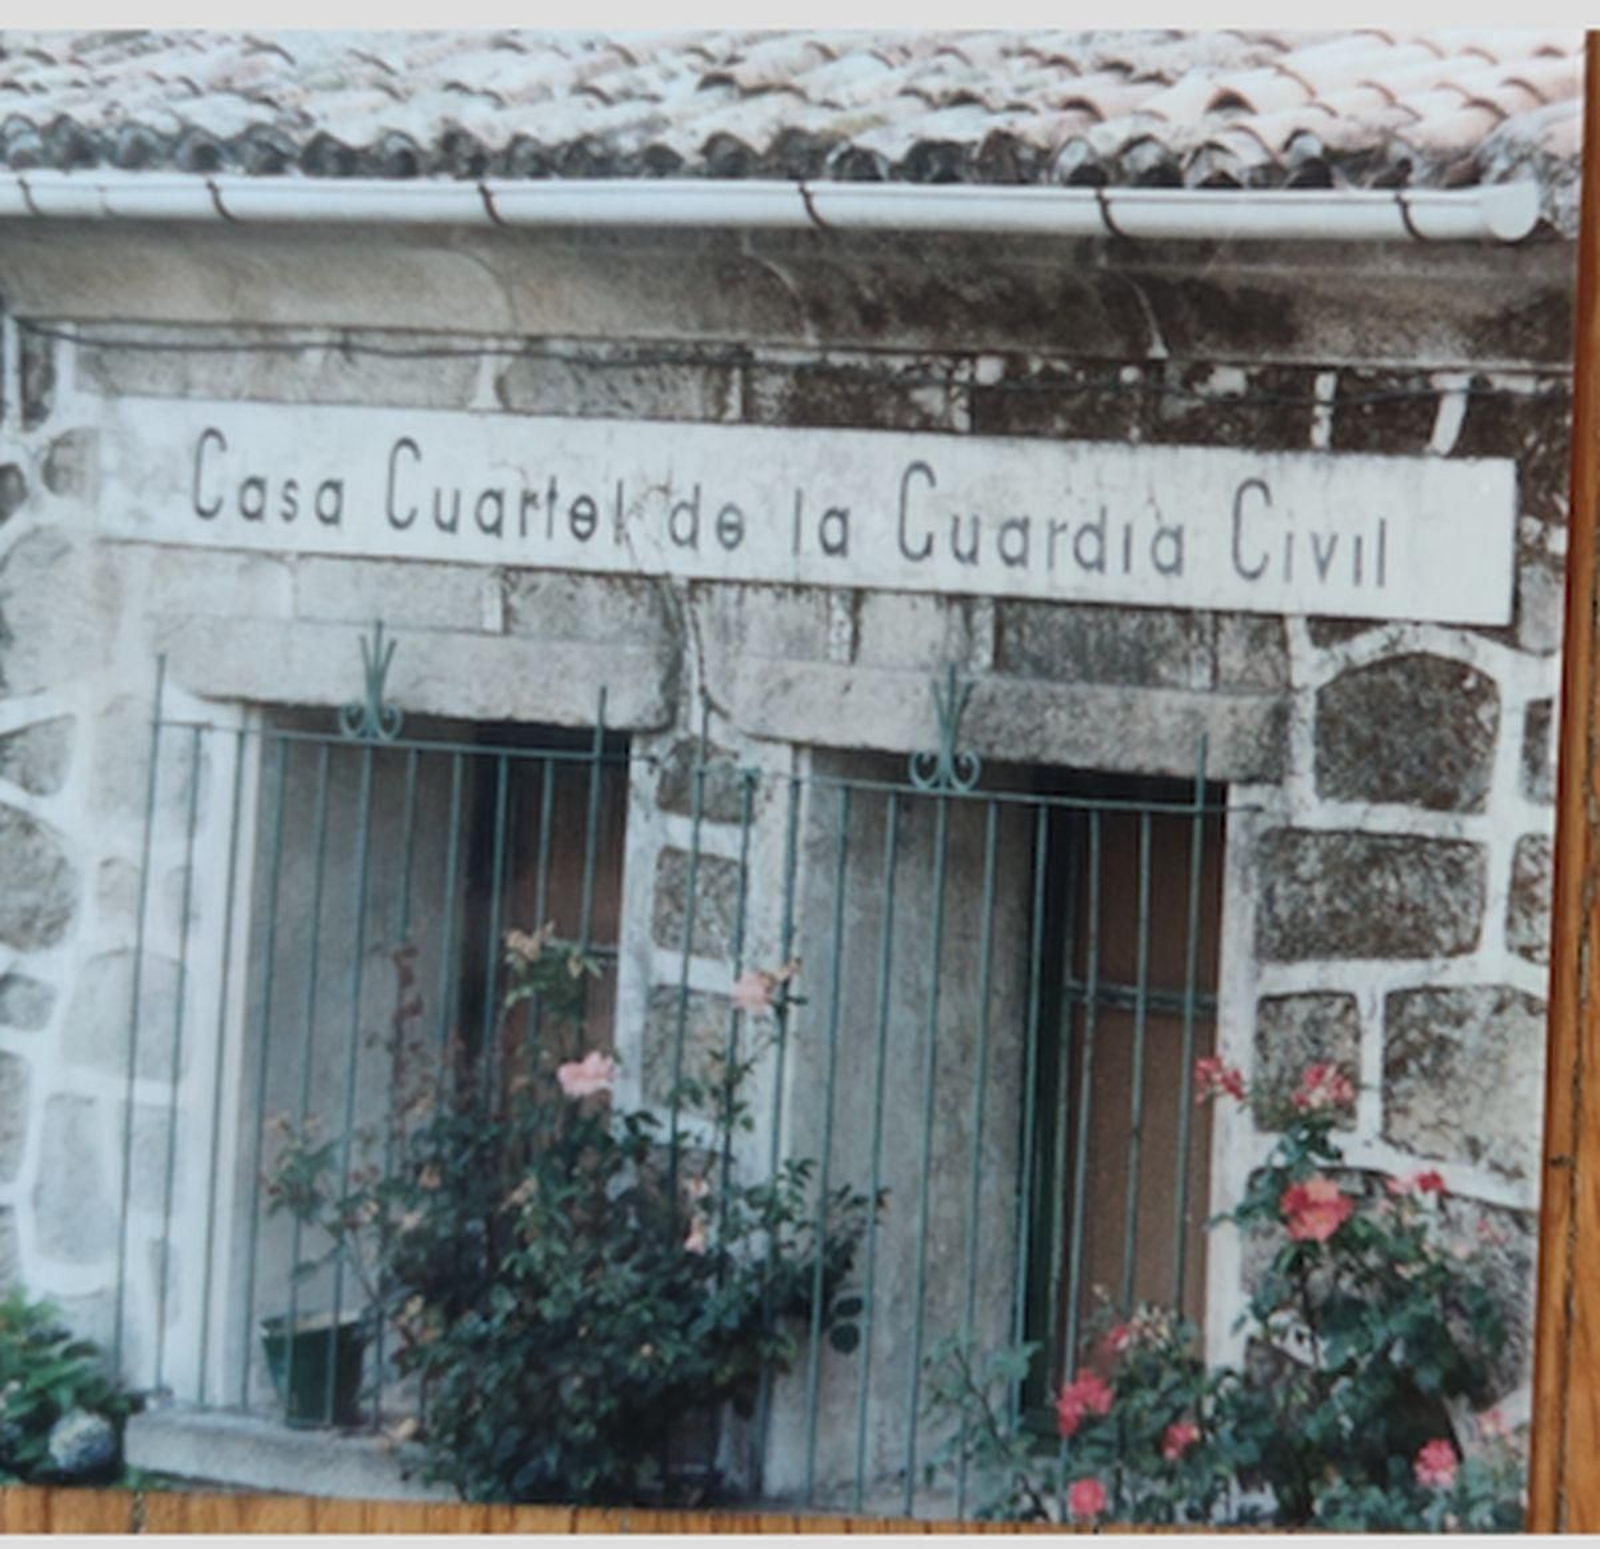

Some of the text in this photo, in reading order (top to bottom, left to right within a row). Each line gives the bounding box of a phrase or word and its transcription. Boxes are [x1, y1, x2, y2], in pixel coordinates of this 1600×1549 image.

[193, 427, 345, 527] Casa
[386, 436, 630, 546] Cuartel
[668, 482, 745, 549] de
[792, 489, 850, 557] la
[1232, 478, 1389, 589] Civil
